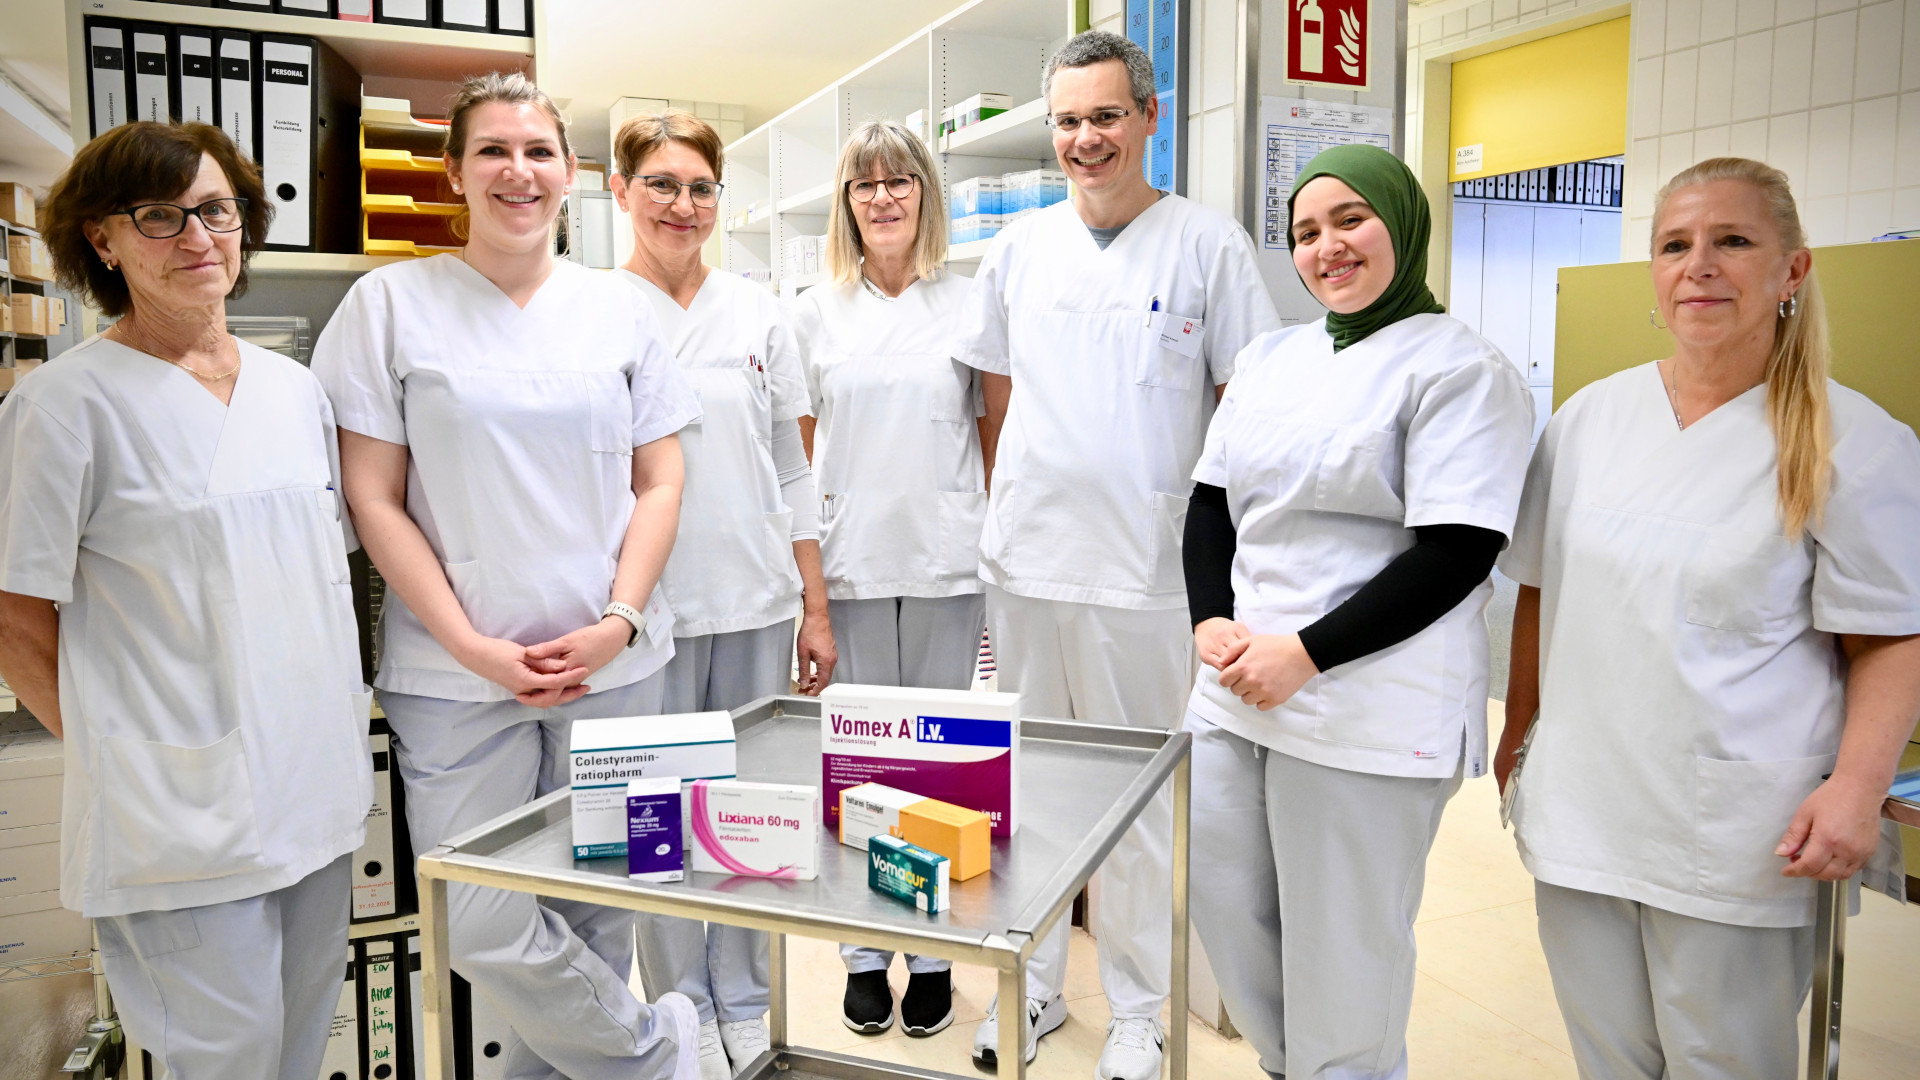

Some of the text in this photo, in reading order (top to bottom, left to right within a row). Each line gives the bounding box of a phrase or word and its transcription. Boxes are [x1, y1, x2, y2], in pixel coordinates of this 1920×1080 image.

[1161, 1, 1170, 16] 30
[1133, 13, 1141, 28] 30
[1161, 36, 1170, 50] 20
[272, 68, 304, 77] PERSONAL
[1161, 71, 1169, 84] 10
[1161, 102, 1168, 118] 0
[1160, 139, 1168, 153] 10
[1159, 173, 1168, 187] 20
[831, 714, 892, 738] Vomex
[918, 718, 944, 741] i.v.
[830, 737, 876, 746] Injektionslösung
[575, 752, 660, 767] Colestyramin-
[846, 795, 864, 808] Voltaren
[718, 811, 800, 830] Lixiana 60 mg
[719, 834, 759, 843] edoxaban
[577, 847, 588, 857] 50
[872, 852, 926, 889] Vomacur
